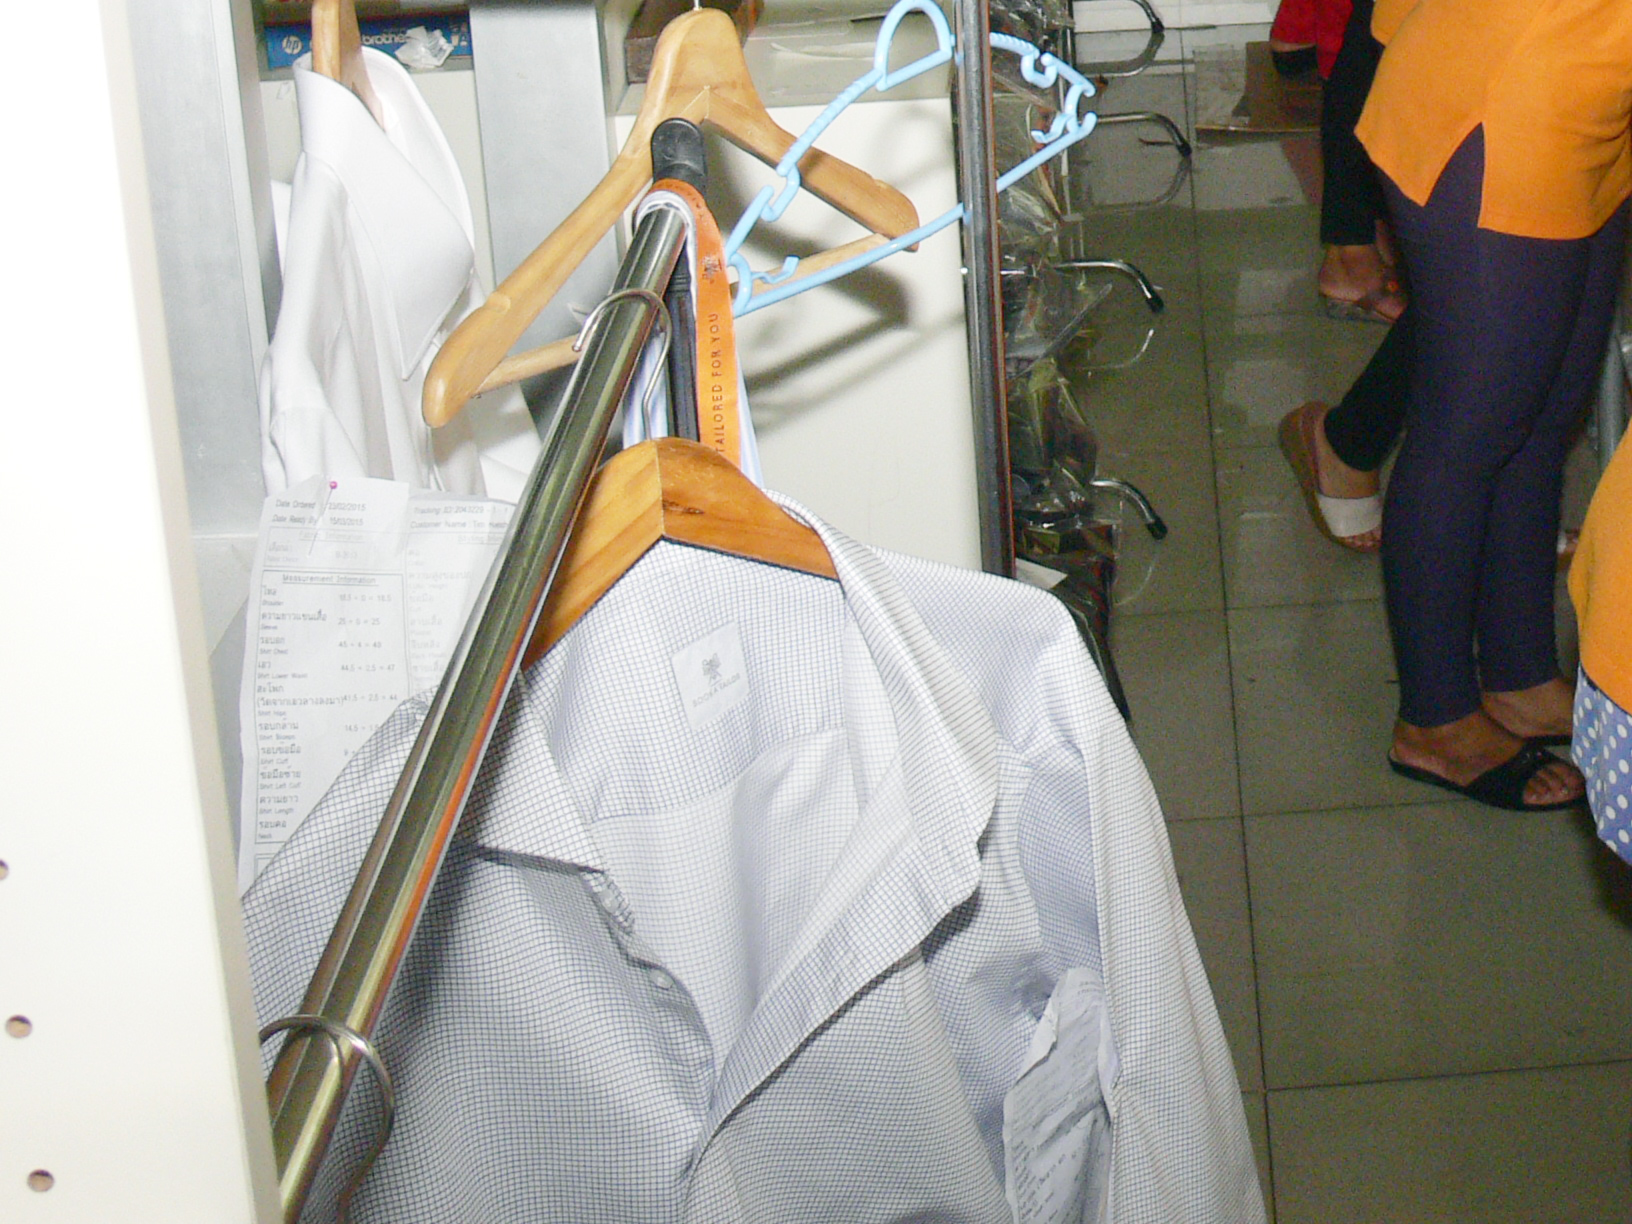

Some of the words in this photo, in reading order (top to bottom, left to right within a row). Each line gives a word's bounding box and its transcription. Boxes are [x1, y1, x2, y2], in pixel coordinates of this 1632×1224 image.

[361, 32, 406, 45] brothe
[708, 313, 720, 345] YOU
[710, 349, 722, 377] FOR
[711, 384, 726, 453] TAILORED
[282, 573, 334, 583] Measurement
[337, 575, 377, 584] Information
